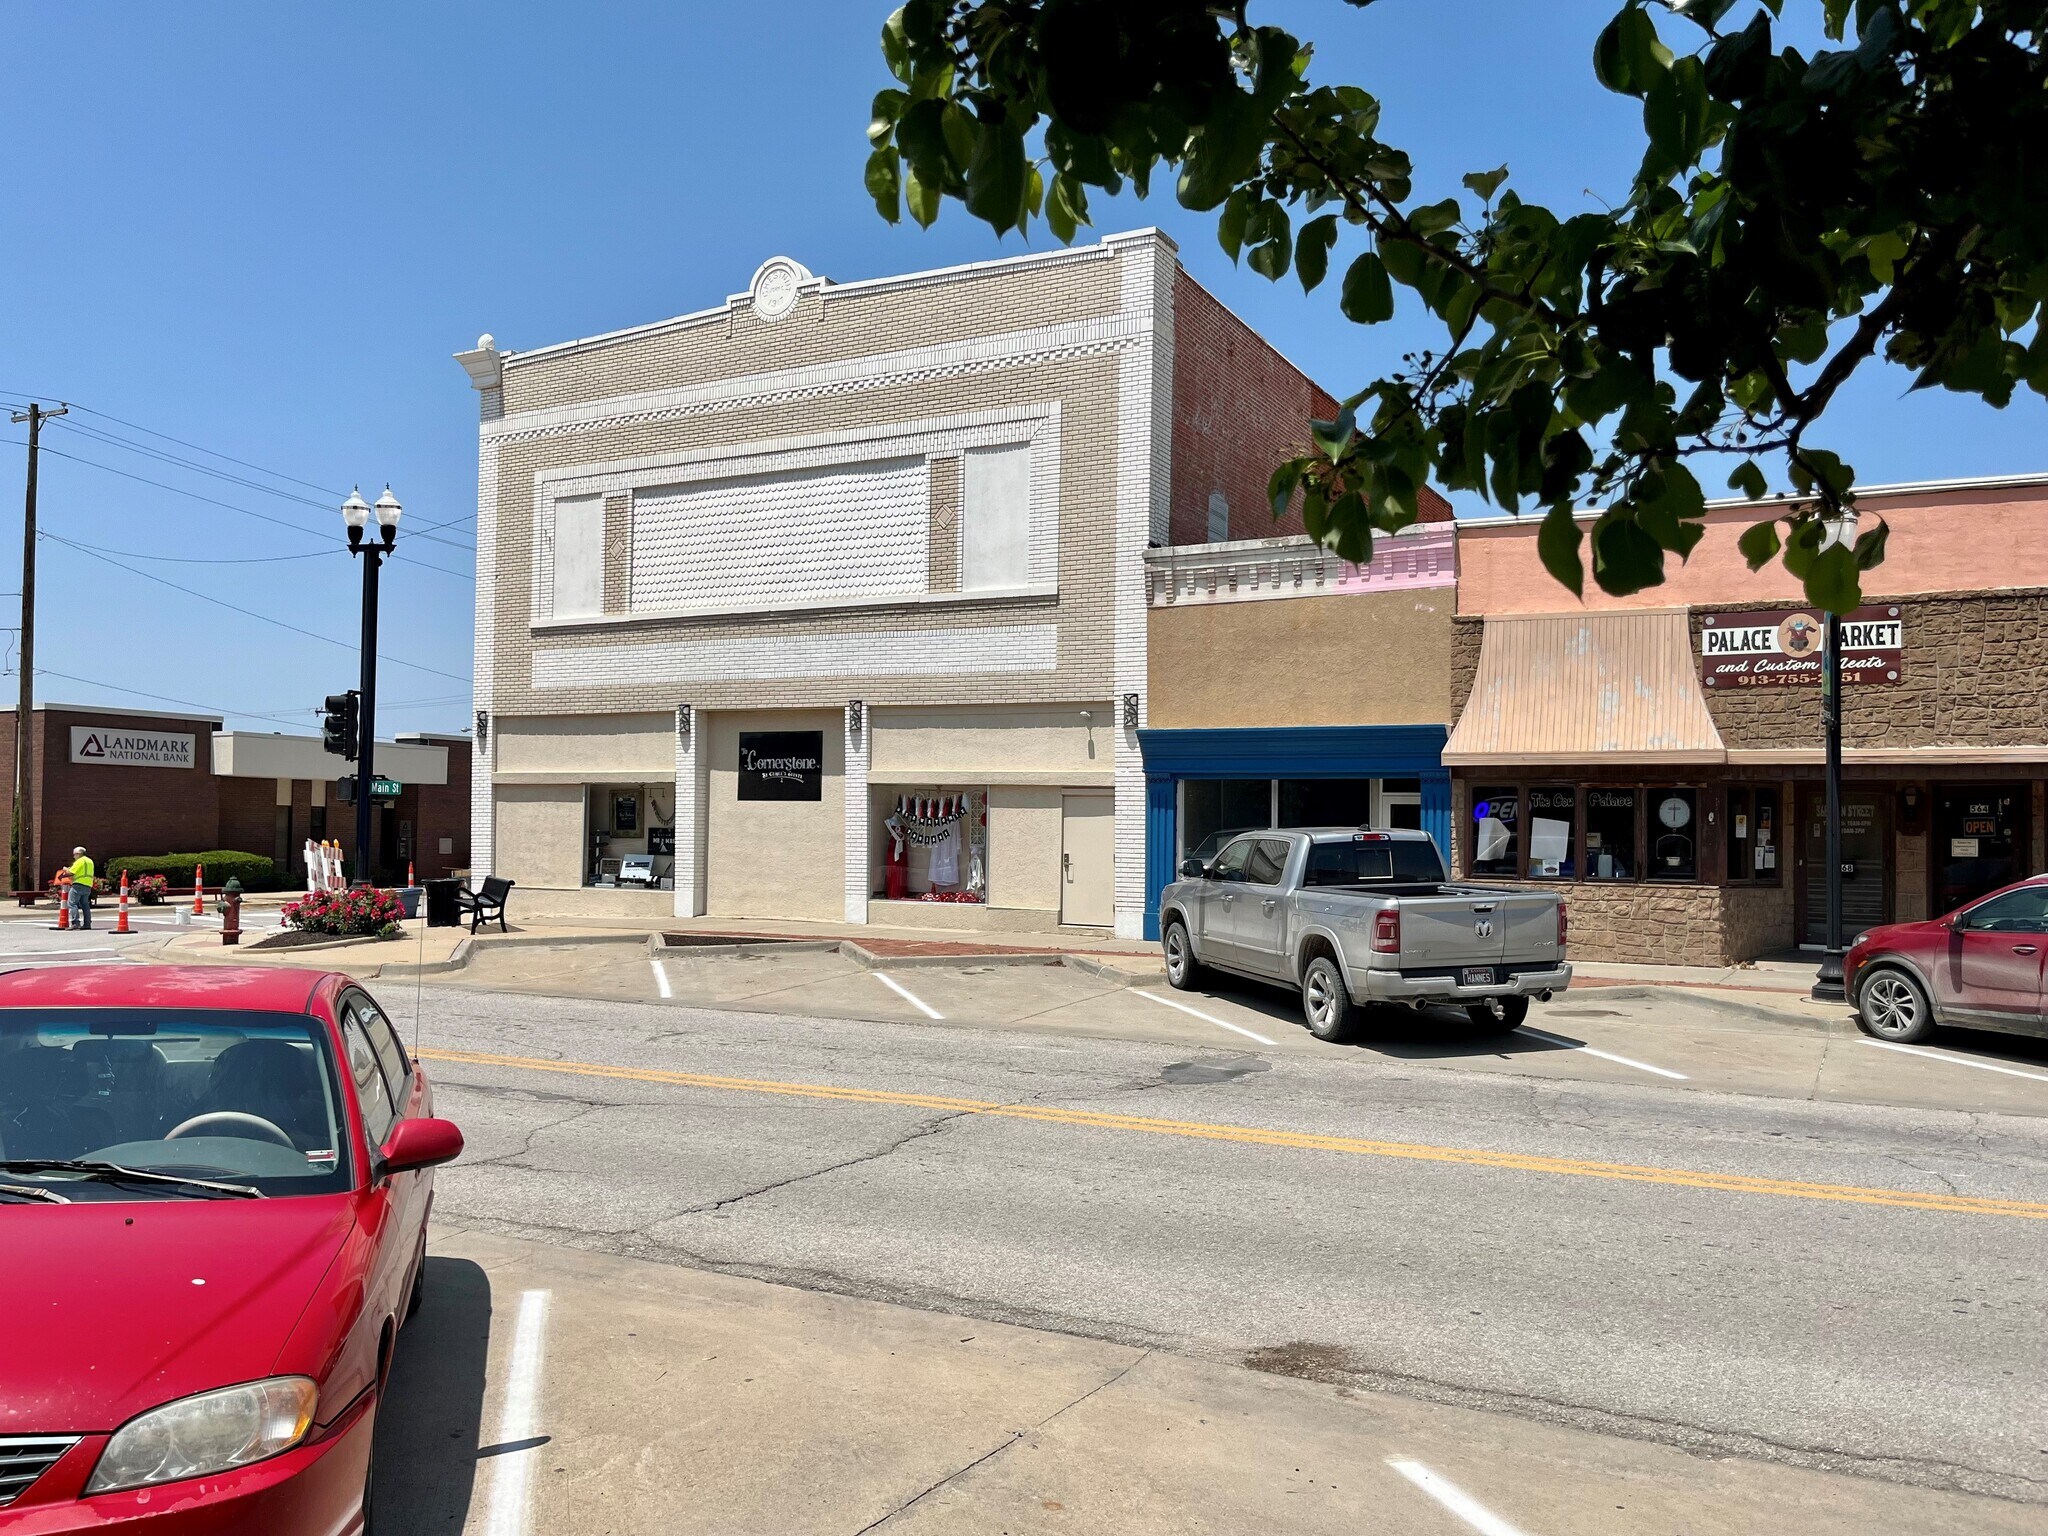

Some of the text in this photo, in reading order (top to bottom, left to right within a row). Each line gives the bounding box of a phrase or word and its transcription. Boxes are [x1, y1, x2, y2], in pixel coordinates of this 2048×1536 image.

[1708, 623, 1900, 653] PALACE ARKET
[1716, 660, 1749, 673] and
[1753, 659, 1820, 673] Custom
[1737, 672, 1861, 686] 913-755-51
[103, 734, 190, 753] LANDMARK
[109, 750, 189, 763] NATIONAL BANK
[747, 750, 816, 771] Cornerstone
[371, 782, 399, 793] Main St
[1531, 792, 1633, 808] The Cow Palace
[1970, 805, 1988, 813] 564
[1966, 821, 1994, 834] OPEN
[1467, 973, 1491, 983] HANNES
